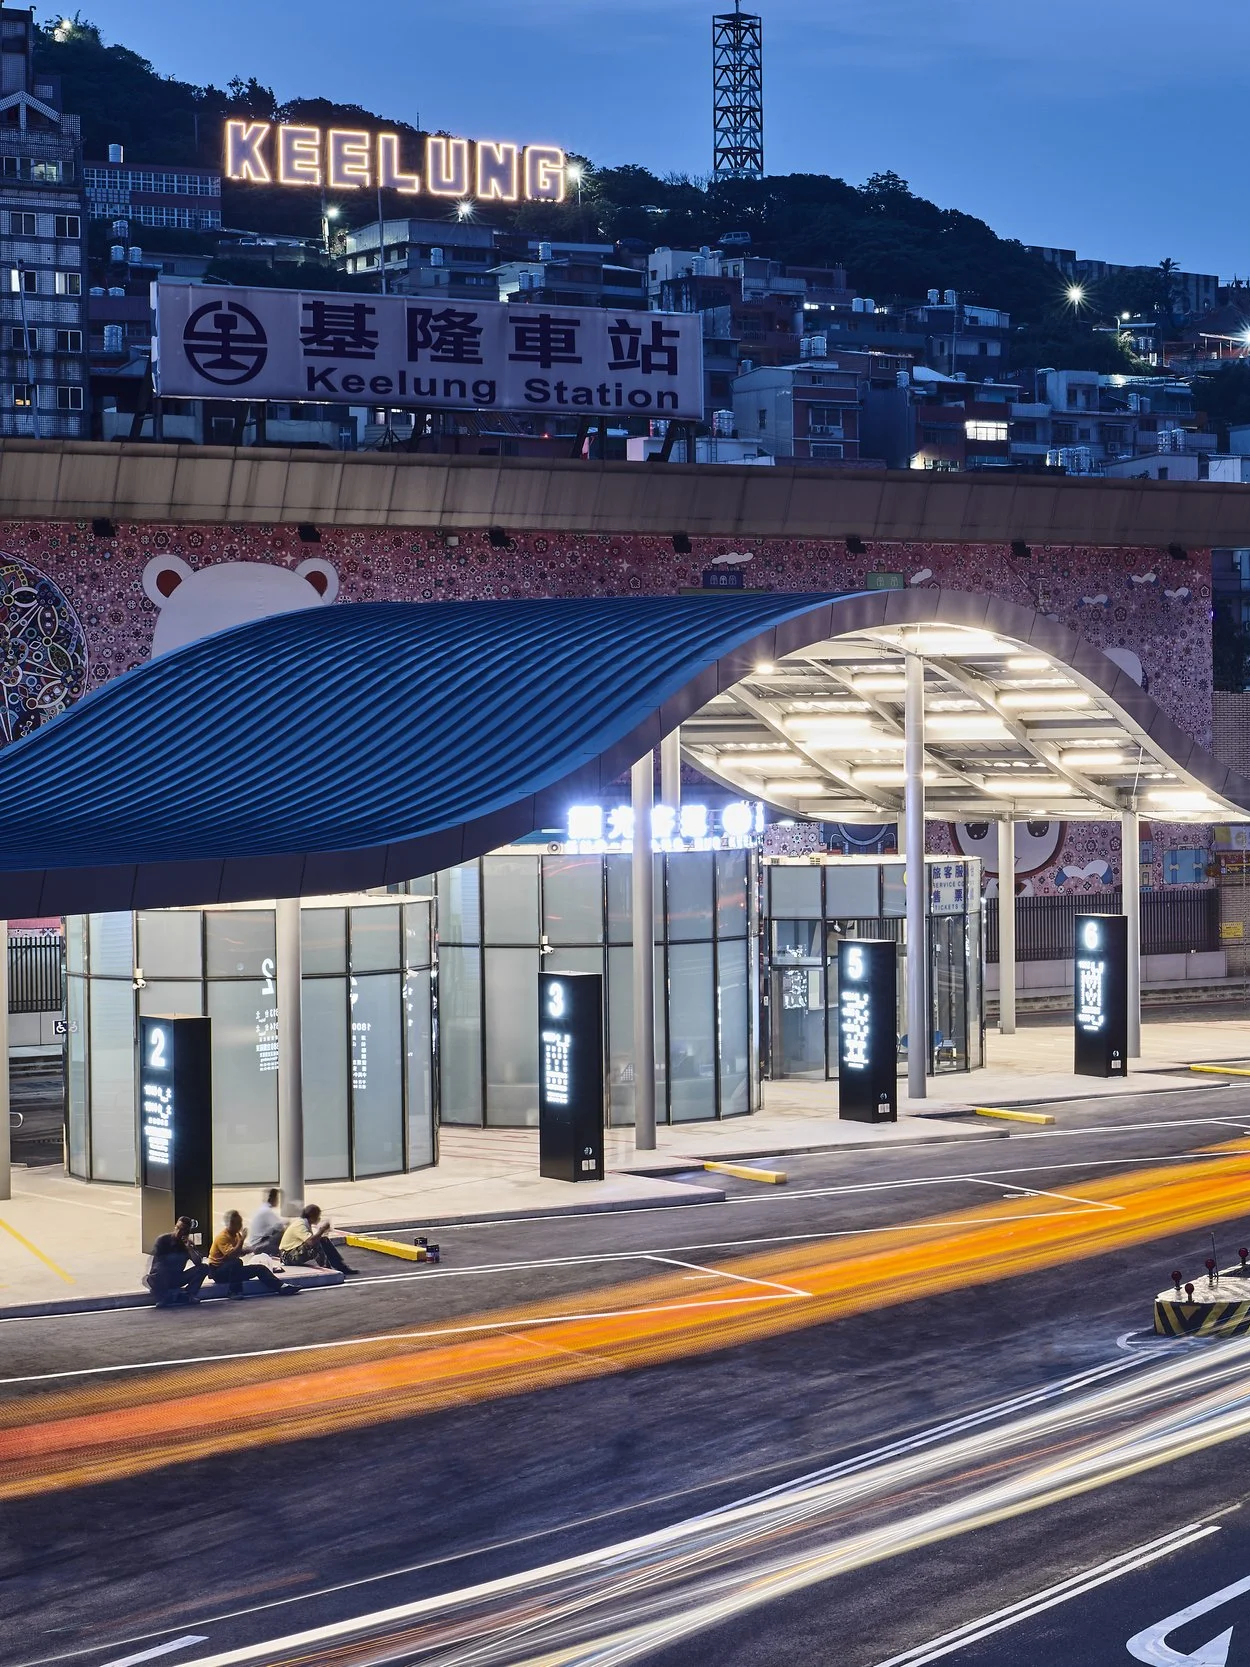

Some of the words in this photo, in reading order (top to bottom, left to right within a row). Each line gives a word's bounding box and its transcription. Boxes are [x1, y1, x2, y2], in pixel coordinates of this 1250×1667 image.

[224, 119, 566, 203] KEELUNG
[300, 300, 681, 376] 基隆車站
[306, 366, 497, 405] Keelung
[524, 377, 680, 410] Station
[1085, 922, 1098, 949] 6
[848, 947, 863, 979] 5
[548, 982, 564, 1017] 3
[151, 1028, 166, 1067] 2
